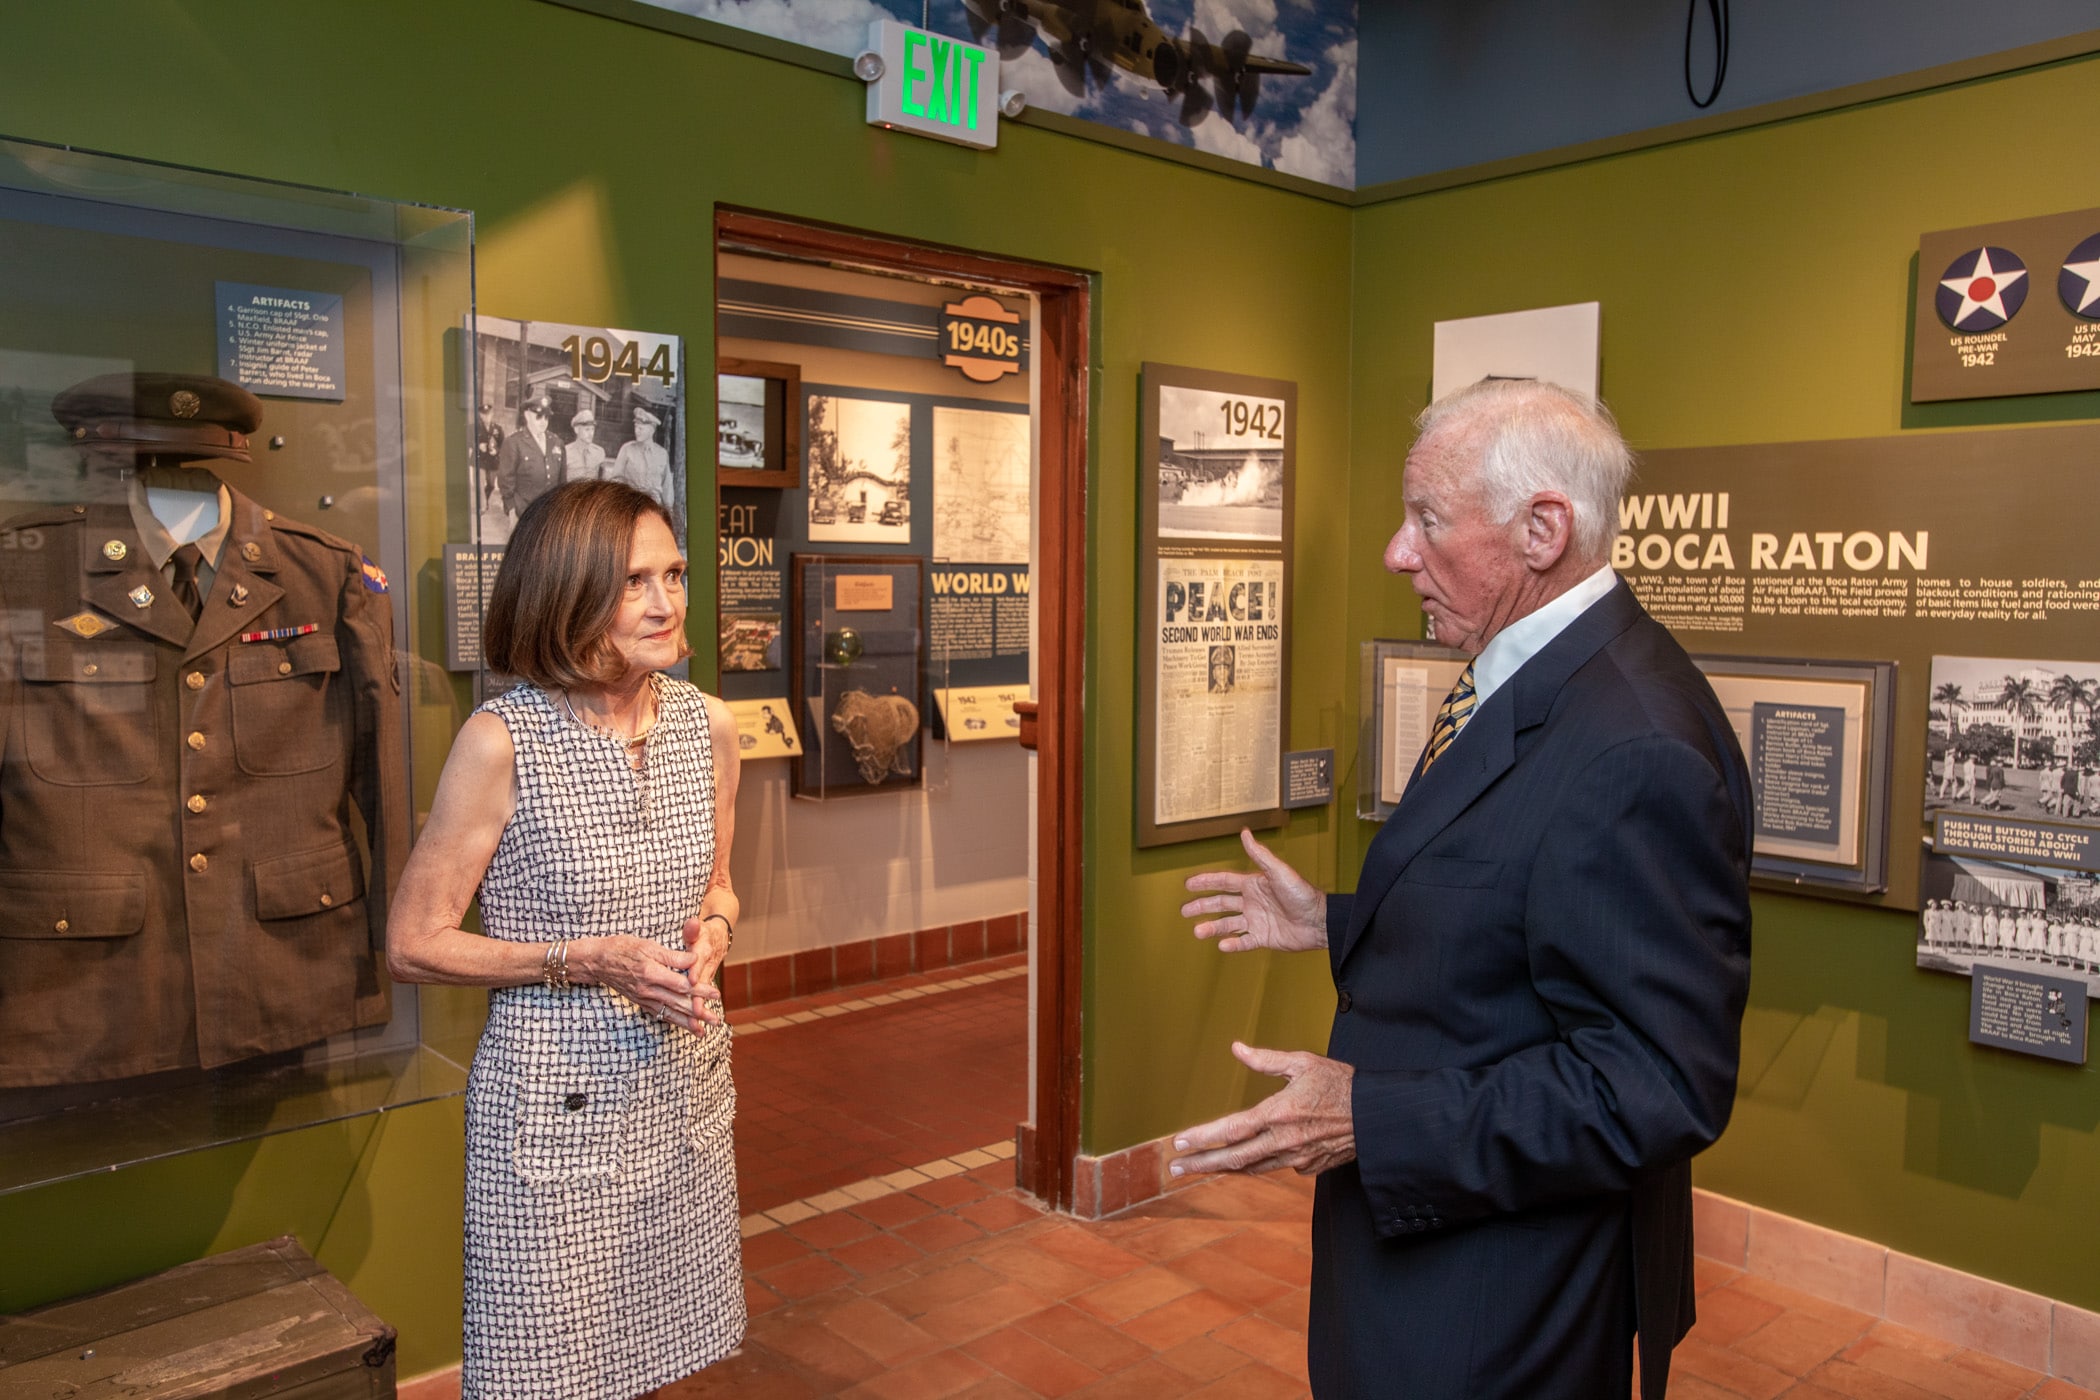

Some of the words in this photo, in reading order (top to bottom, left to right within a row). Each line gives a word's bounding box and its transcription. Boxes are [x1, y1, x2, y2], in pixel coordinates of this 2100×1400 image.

[902, 29, 985, 130] EXIT
[252, 296, 310, 310] ARTIFACTS
[237, 306, 268, 315] Garrison
[238, 322, 261, 330] N.C.O.
[263, 324, 291, 333] Enlisted
[2075, 326, 2088, 334] US
[254, 331, 273, 340] Army
[946, 321, 1018, 356] 1940s
[1951, 338, 1962, 346] US
[1964, 333, 2008, 345] ROUNDEL
[2072, 334, 2095, 343] MAY
[266, 340, 295, 348] uniform
[1958, 343, 1998, 354] PRE-WAR
[2065, 343, 2100, 358] 1942
[561, 335, 676, 388] 1944
[1961, 353, 1994, 367] 1942
[263, 378, 287, 388] during
[1220, 400, 1282, 440] 1942
[1619, 492, 1729, 530] WWII
[456, 552, 488, 560] BRAF
[1611, 534, 1735, 570] BOCA
[1751, 531, 1928, 570] RATON
[930, 572, 1008, 594] WORLD
[1640, 576, 1664, 584] WW2,
[1725, 576, 1745, 585] Boca
[1753, 576, 1793, 586] stationed
[1796, 577, 1805, 586] at
[1808, 577, 1823, 586] the
[1826, 577, 1847, 586] Boca
[1851, 578, 1878, 586] Raton
[1882, 578, 1908, 588] Army
[1917, 577, 1950, 587] homes
[1960, 578, 1971, 587] to
[1980, 577, 2012, 588] house
[2022, 578, 2067, 590] soldiers,
[2079, 578, 2100, 589] and
[1663, 585, 1706, 594] population
[1753, 586, 1766, 595] Air
[1768, 586, 1788, 595] Field
[1791, 586, 1828, 596] (BRAAF).
[1850, 587, 1871, 596] Field
[1875, 588, 1908, 598] proved
[1917, 588, 1960, 598] blackout
[1963, 588, 2018, 598] conditions
[2022, 589, 2043, 598] and
[2048, 589, 2100, 602] rationing
[1166, 581, 1276, 622] PEACE!
[1764, 596, 1775, 604] be
[1785, 595, 1807, 604] boon
[1822, 596, 1837, 605] the
[1840, 597, 1860, 605] local
[1863, 598, 1907, 608] economy.
[1916, 598, 1926, 607] of
[1928, 598, 1951, 608] basic
[1953, 598, 1979, 608] items
[1981, 598, 1998, 608] like
[2001, 599, 2020, 609] fuel
[2023, 599, 2043, 609] and
[2046, 600, 2070, 610] food
[2073, 602, 2099, 610] were
[1752, 605, 1776, 615] Many
[1780, 605, 1800, 614] local
[1804, 606, 1838, 615] citizens
[1842, 606, 1878, 617] opened
[1883, 607, 1906, 616] their
[1930, 609, 1975, 620] everyday
[1978, 610, 2010, 621] reality
[2014, 610, 2029, 620] for
[2032, 610, 2047, 620] all.
[1162, 626, 1198, 644] SECOND
[1201, 626, 1231, 641] WORLD
[1234, 626, 1254, 640] WAR
[1256, 625, 1278, 640] ENDS
[1775, 710, 1816, 720] ARTIFACTS
[1944, 820, 1970, 831] PUSH
[1974, 824, 1992, 833] THE
[1996, 827, 2036, 838] BUTTON
[2040, 831, 2054, 840] TO
[2058, 833, 2089, 844] CYCLE
[1944, 829, 1992, 842] THROUGH
[1996, 835, 2035, 847] STORIES
[2039, 840, 2075, 851] ABOUT
[1944, 837, 1970, 848] BOCA
[1973, 841, 2005, 852] RATON
[2009, 846, 2050, 857] DURING
[2053, 850, 2080, 861] WWII
